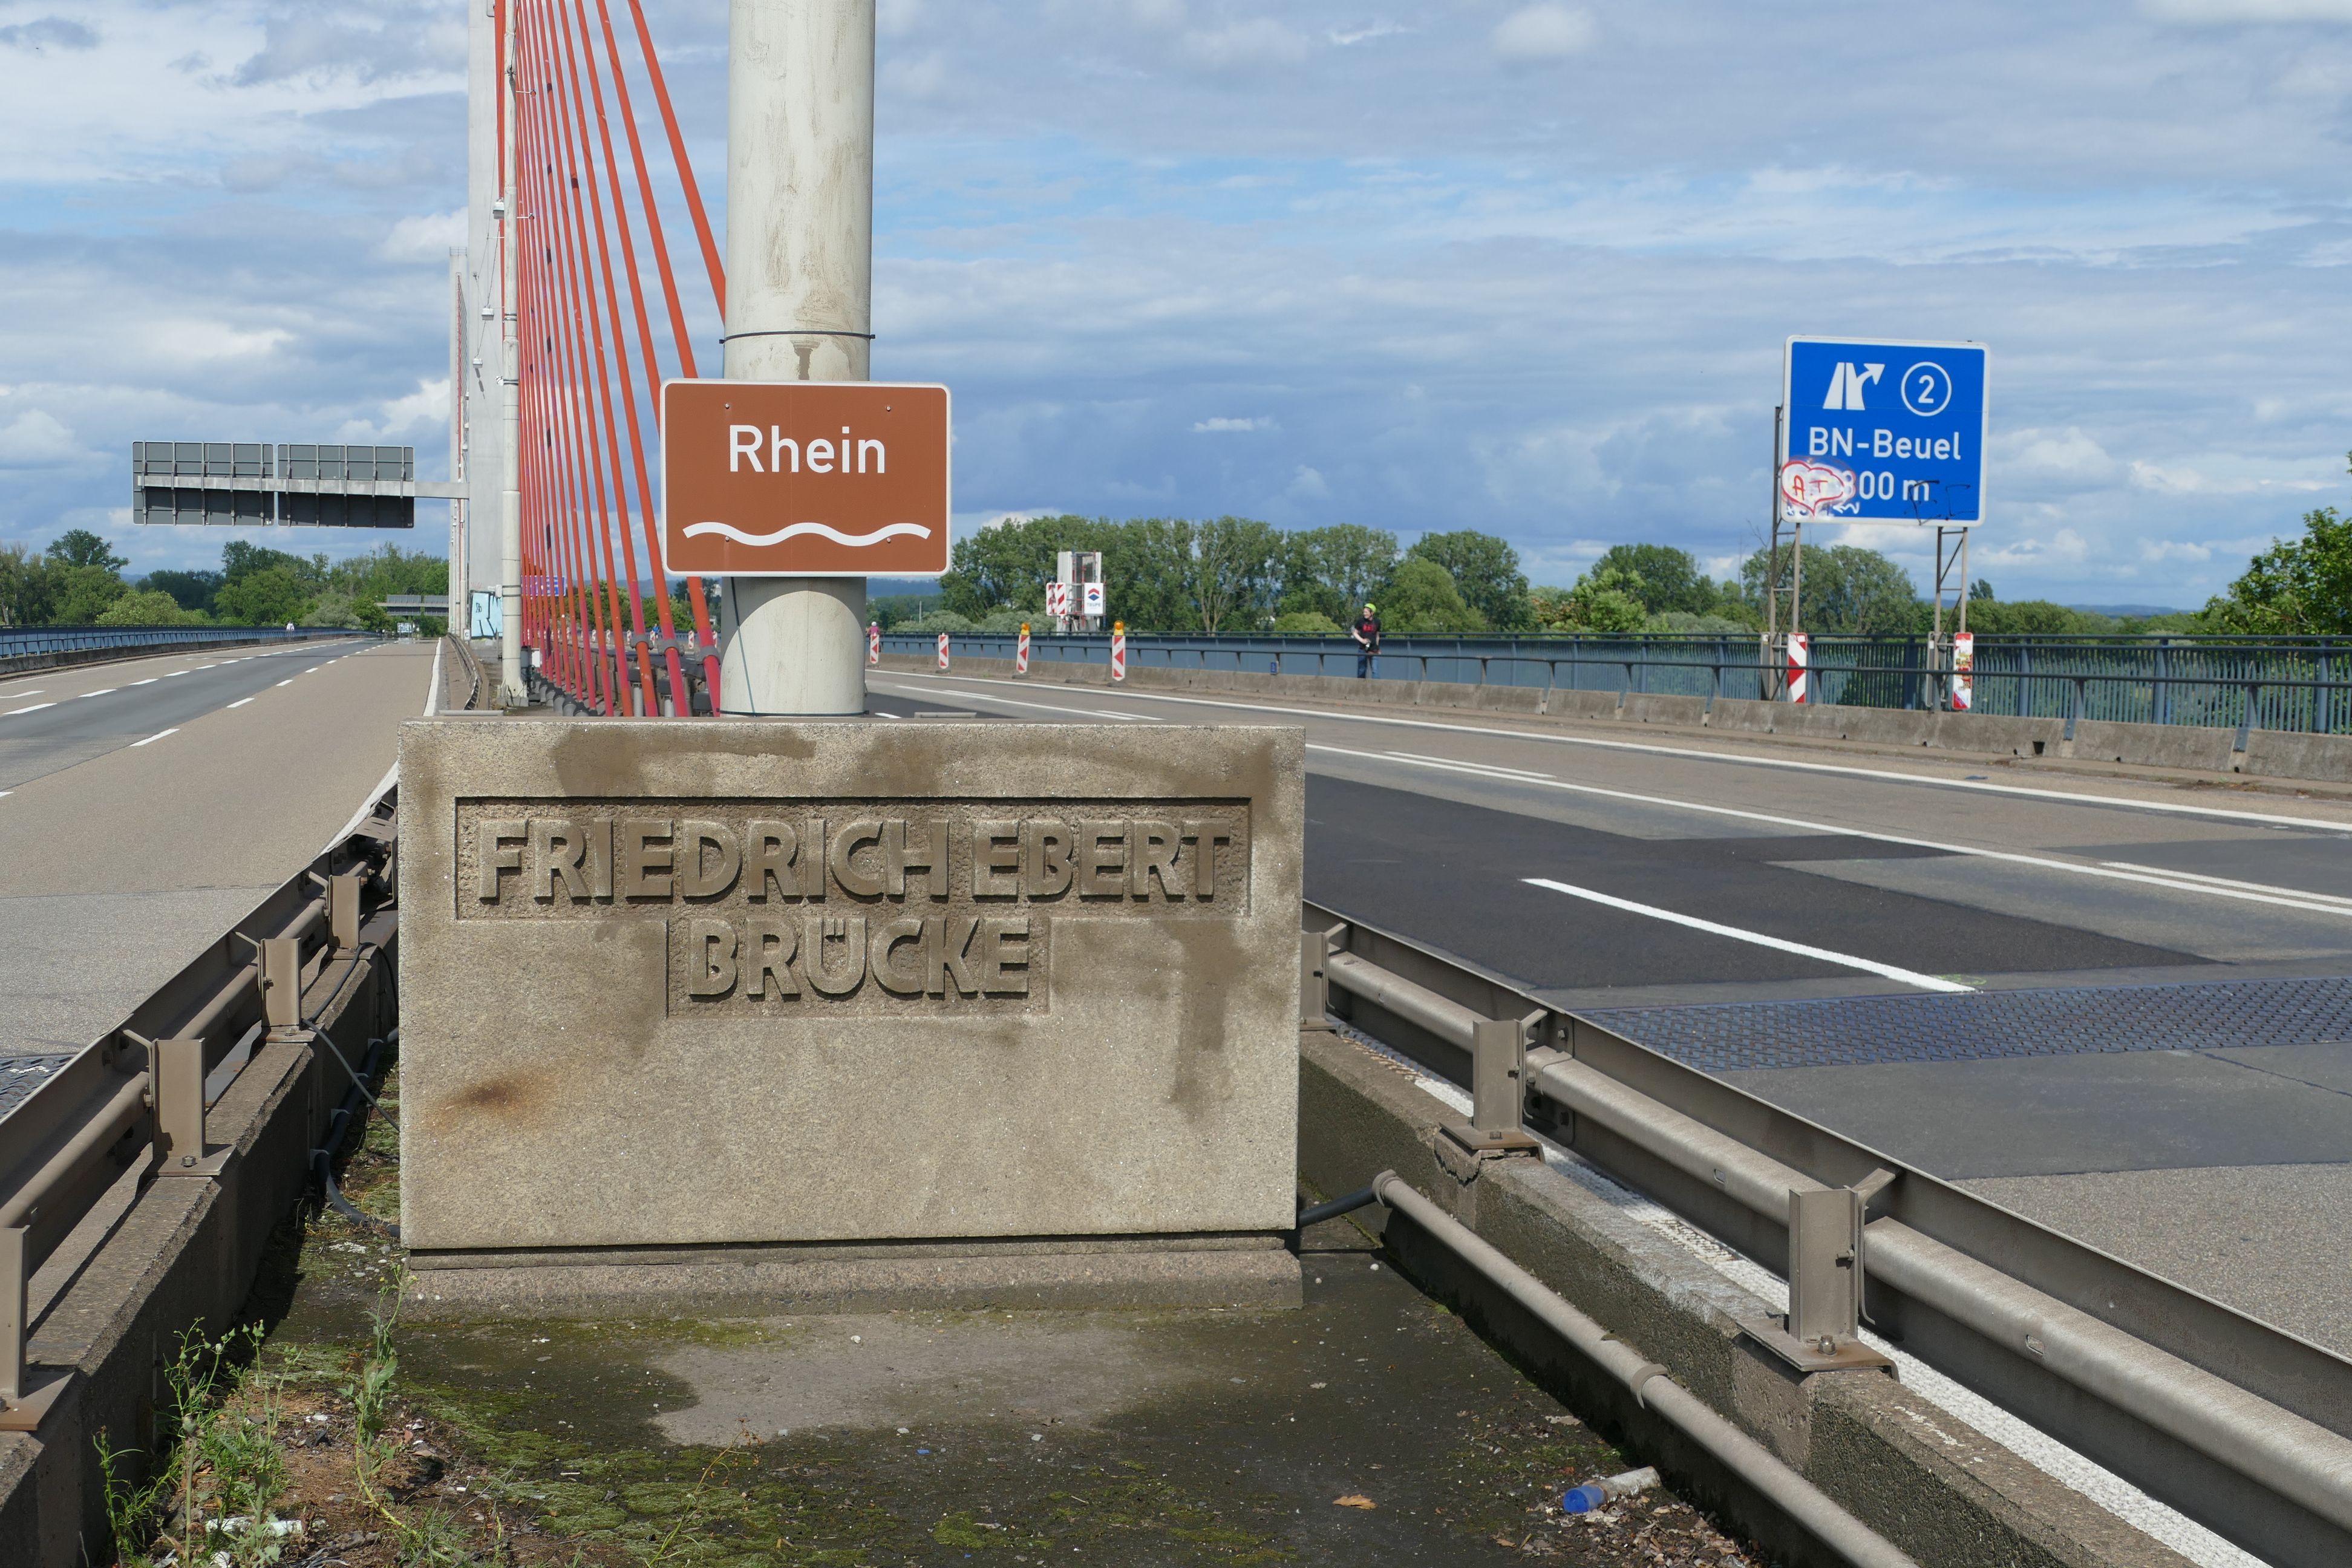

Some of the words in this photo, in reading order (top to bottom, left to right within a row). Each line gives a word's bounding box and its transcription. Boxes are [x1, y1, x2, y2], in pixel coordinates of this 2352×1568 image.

[1918, 374, 1935, 404] 2
[729, 424, 886, 474] Rhein
[1809, 426, 1961, 460] BN-Beuel
[1902, 479, 1930, 501] m
[479, 817, 949, 901] FRIEDRICH
[972, 818, 1230, 901] EBERT
[688, 916, 1029, 999] BRÜCKE
